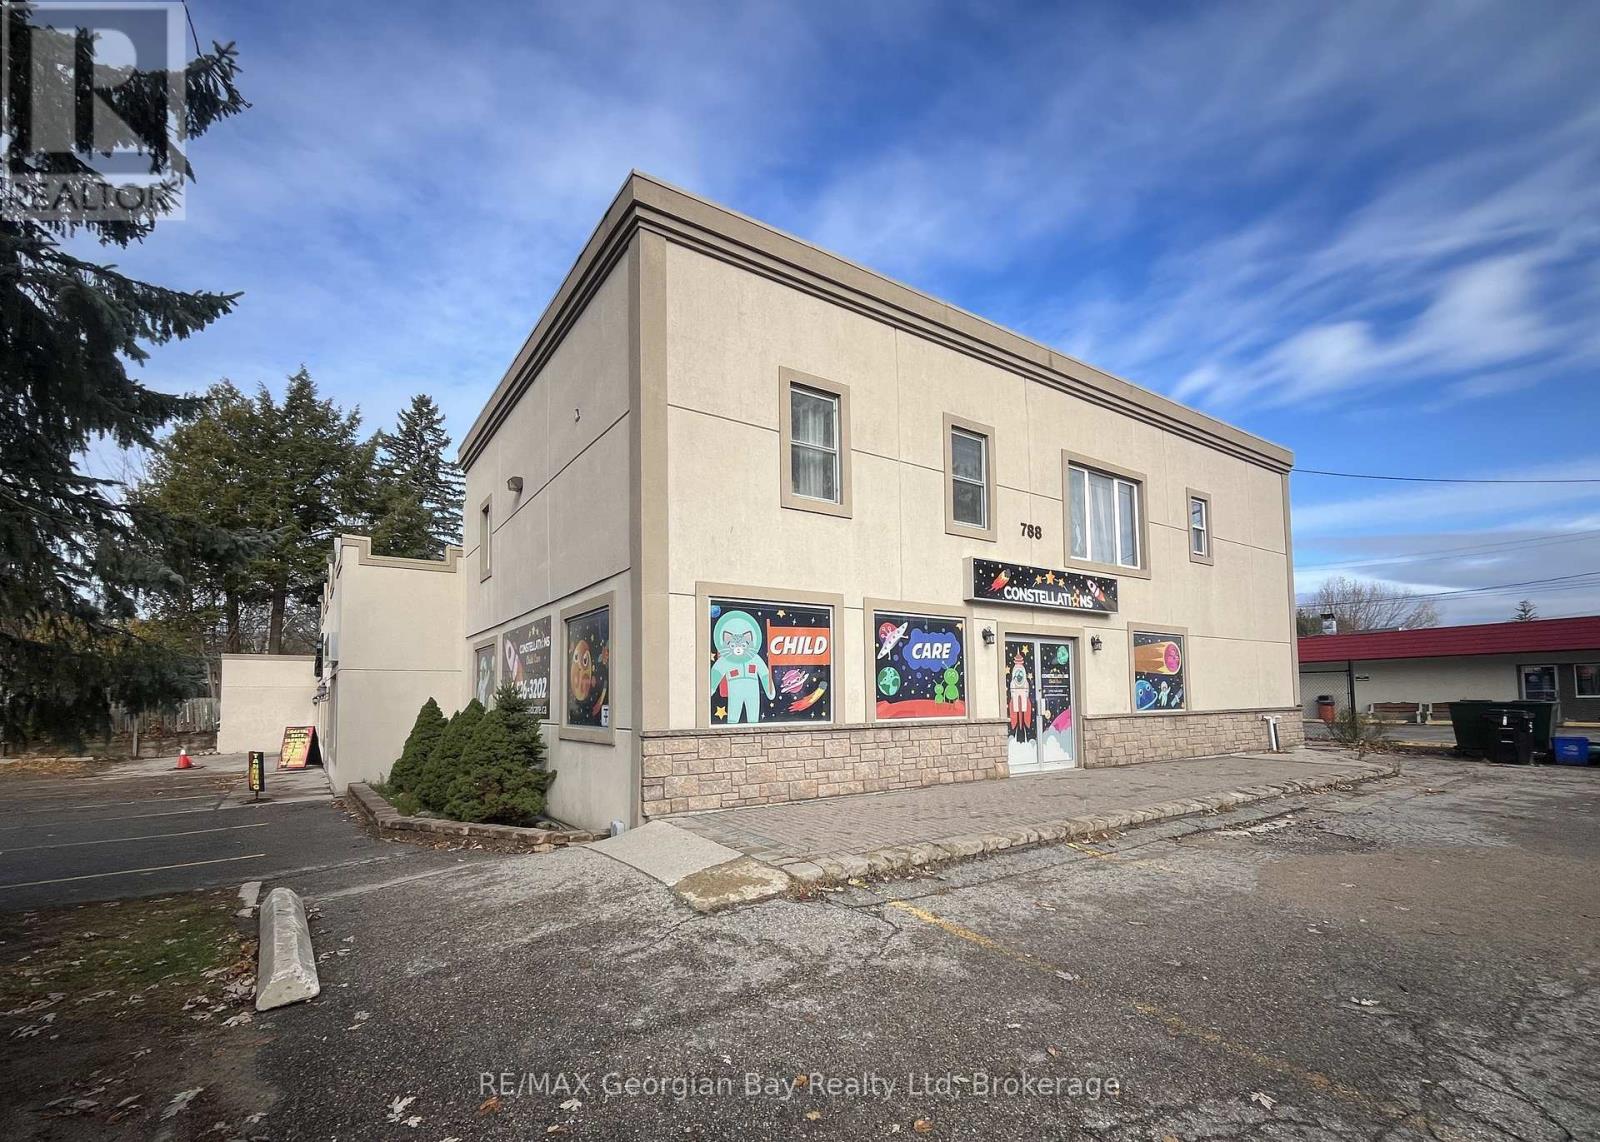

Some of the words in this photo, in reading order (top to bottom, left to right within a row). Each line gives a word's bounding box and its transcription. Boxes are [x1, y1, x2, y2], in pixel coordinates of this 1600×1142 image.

[1020, 522, 1042, 540] 788
[769, 635, 828, 655] CHILD
[911, 642, 951, 660] CARE
